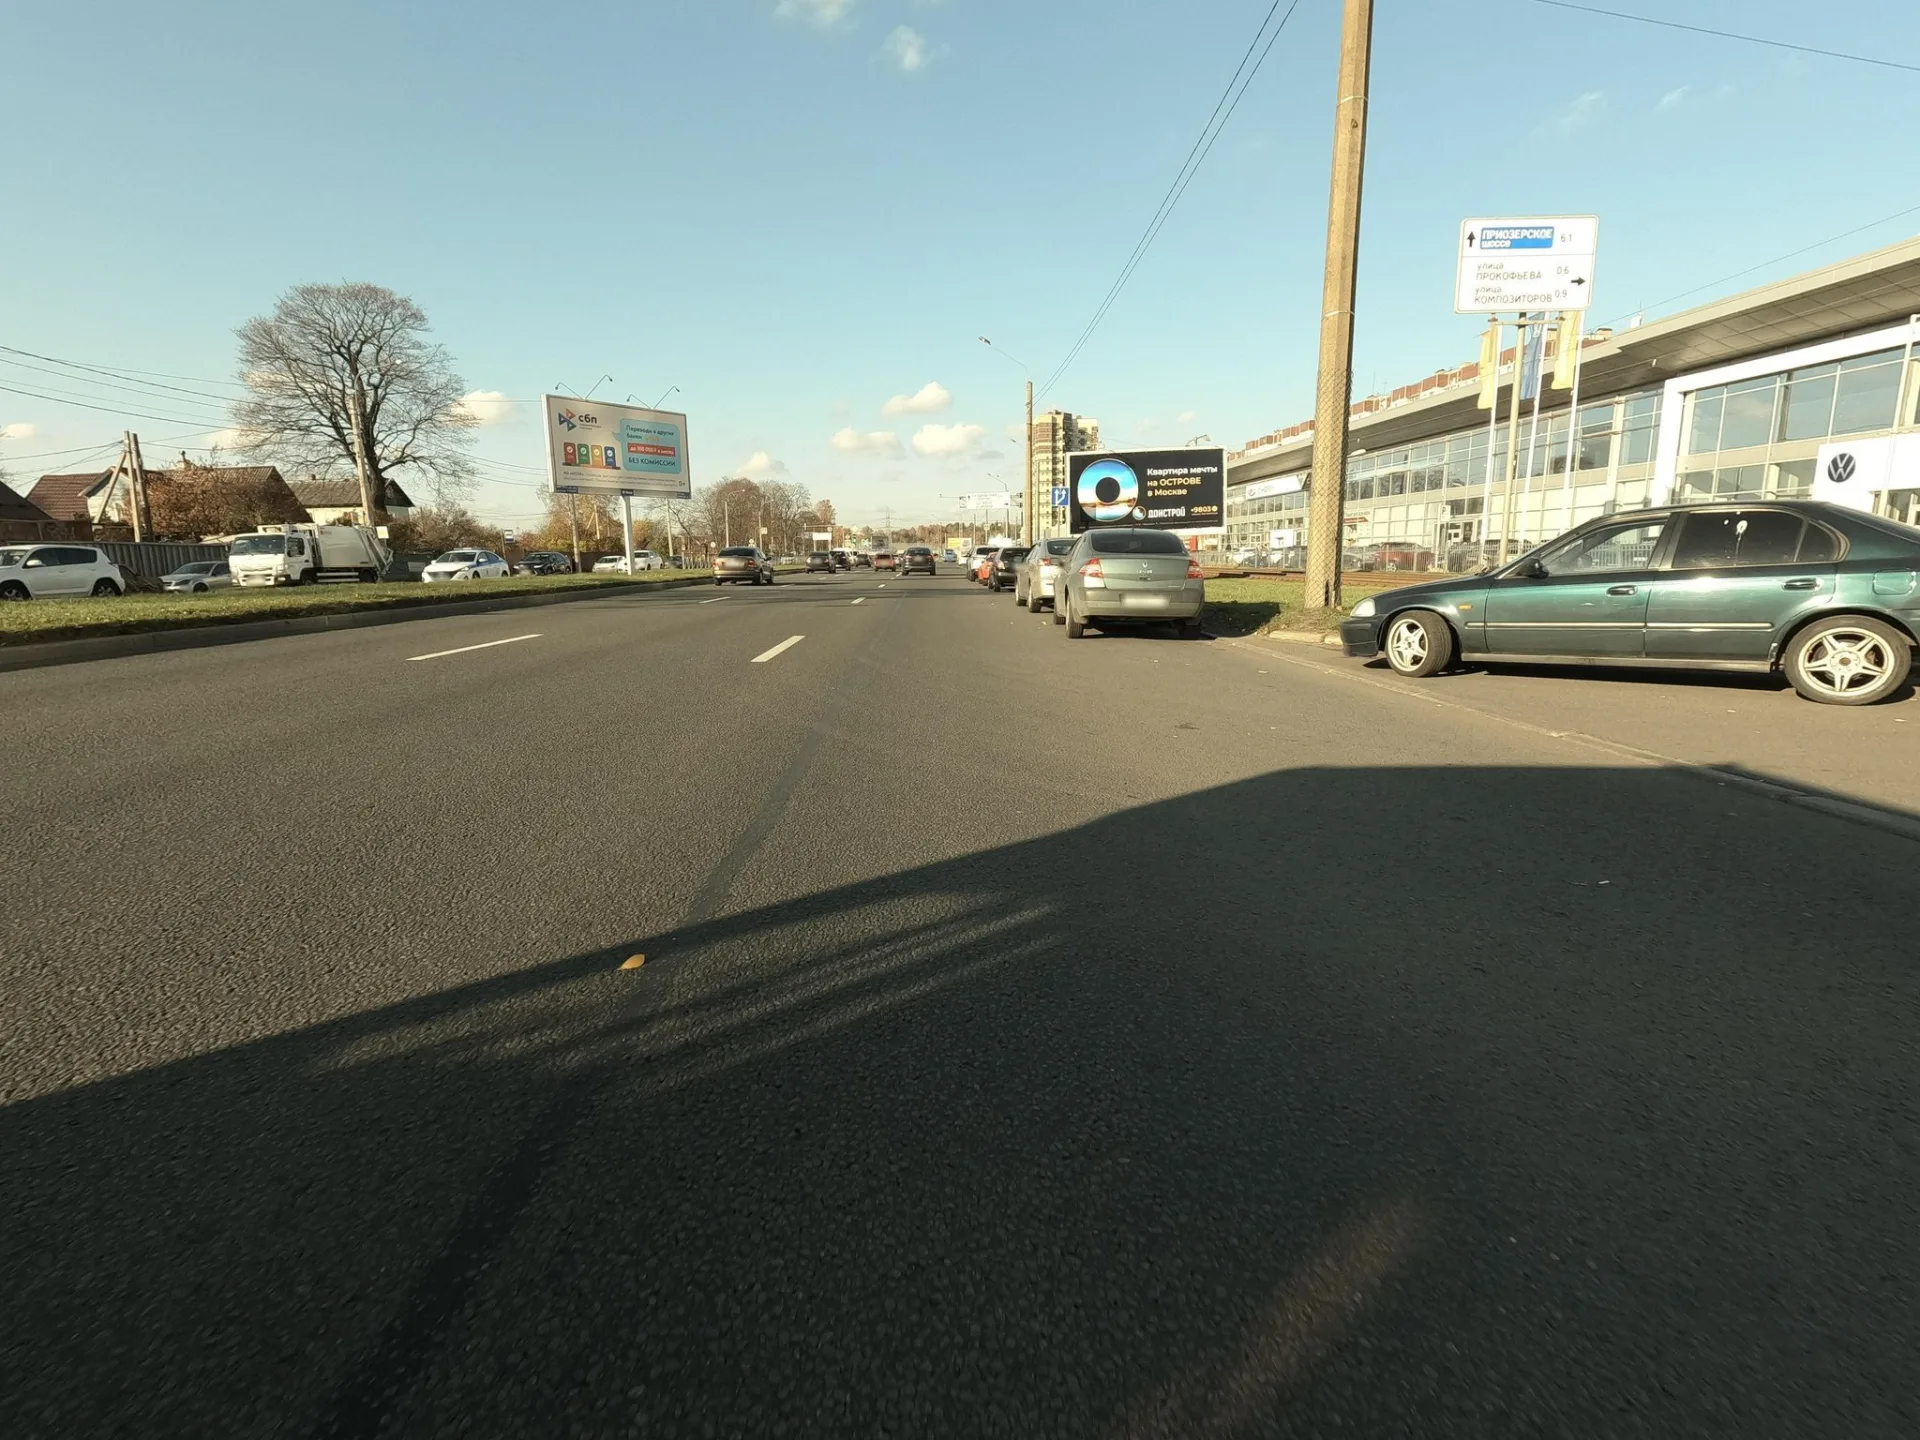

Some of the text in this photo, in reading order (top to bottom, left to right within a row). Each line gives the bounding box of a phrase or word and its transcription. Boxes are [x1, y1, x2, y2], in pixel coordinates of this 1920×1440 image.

[1482, 228, 1553, 240] ПРИОЗЕРСКОЕ
[1477, 262, 1504, 271] улица
[1476, 272, 1542, 280] ПРОКОФЬЕВА
[1475, 286, 1502, 295] улица
[1474, 294, 1552, 304] КОМПОЗИТОРОВ
[578, 414, 598, 424] сбп
[640, 458, 676, 466] КОМИССИИ
[1147, 468, 1188, 476] Квартира
[1160, 476, 1202, 486] ОСТРОВЕ
[1148, 506, 1186, 518] ДОНСТРОЙ
